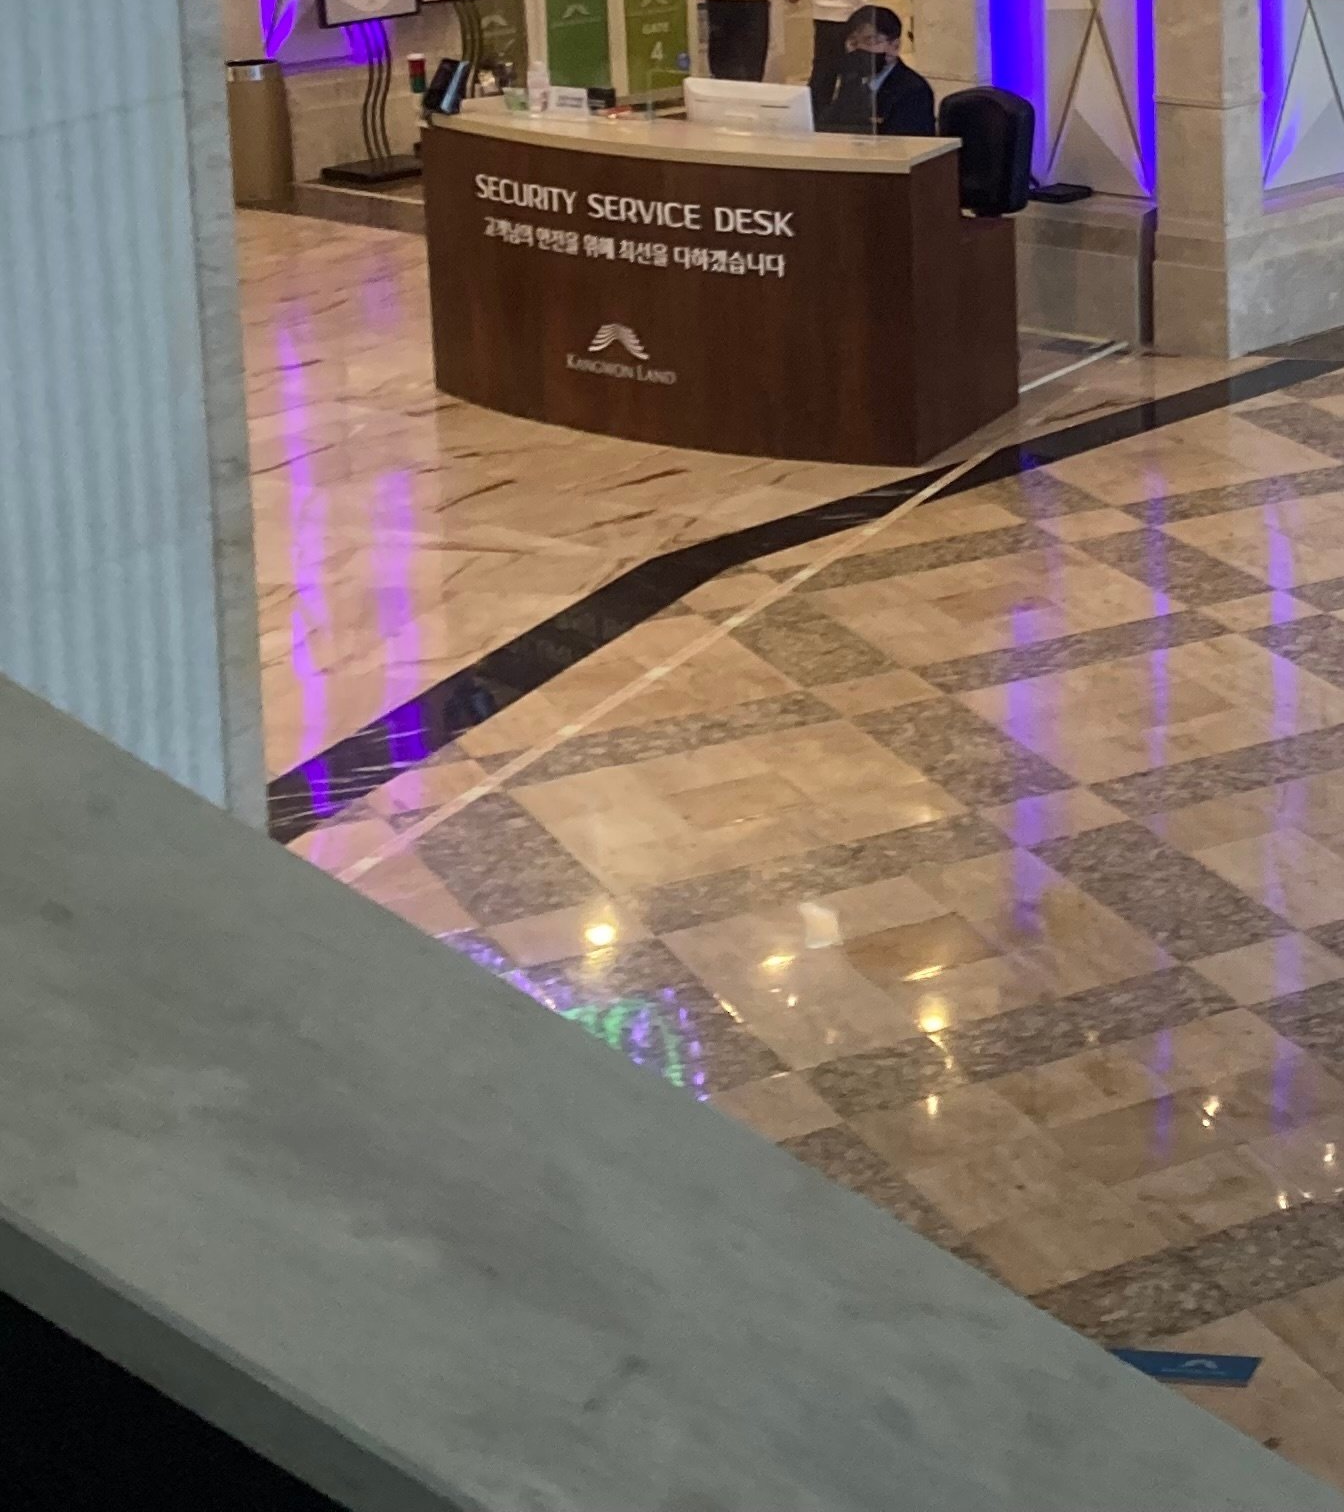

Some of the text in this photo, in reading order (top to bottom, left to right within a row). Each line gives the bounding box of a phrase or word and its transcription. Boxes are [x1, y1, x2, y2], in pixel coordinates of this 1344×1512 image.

[650, 40, 664, 61] 4
[475, 174, 796, 238] SECURITY SERVICE DESK
[484, 216, 786, 278] 고객님의 안전을 위해 최선을 다하겠습니다
